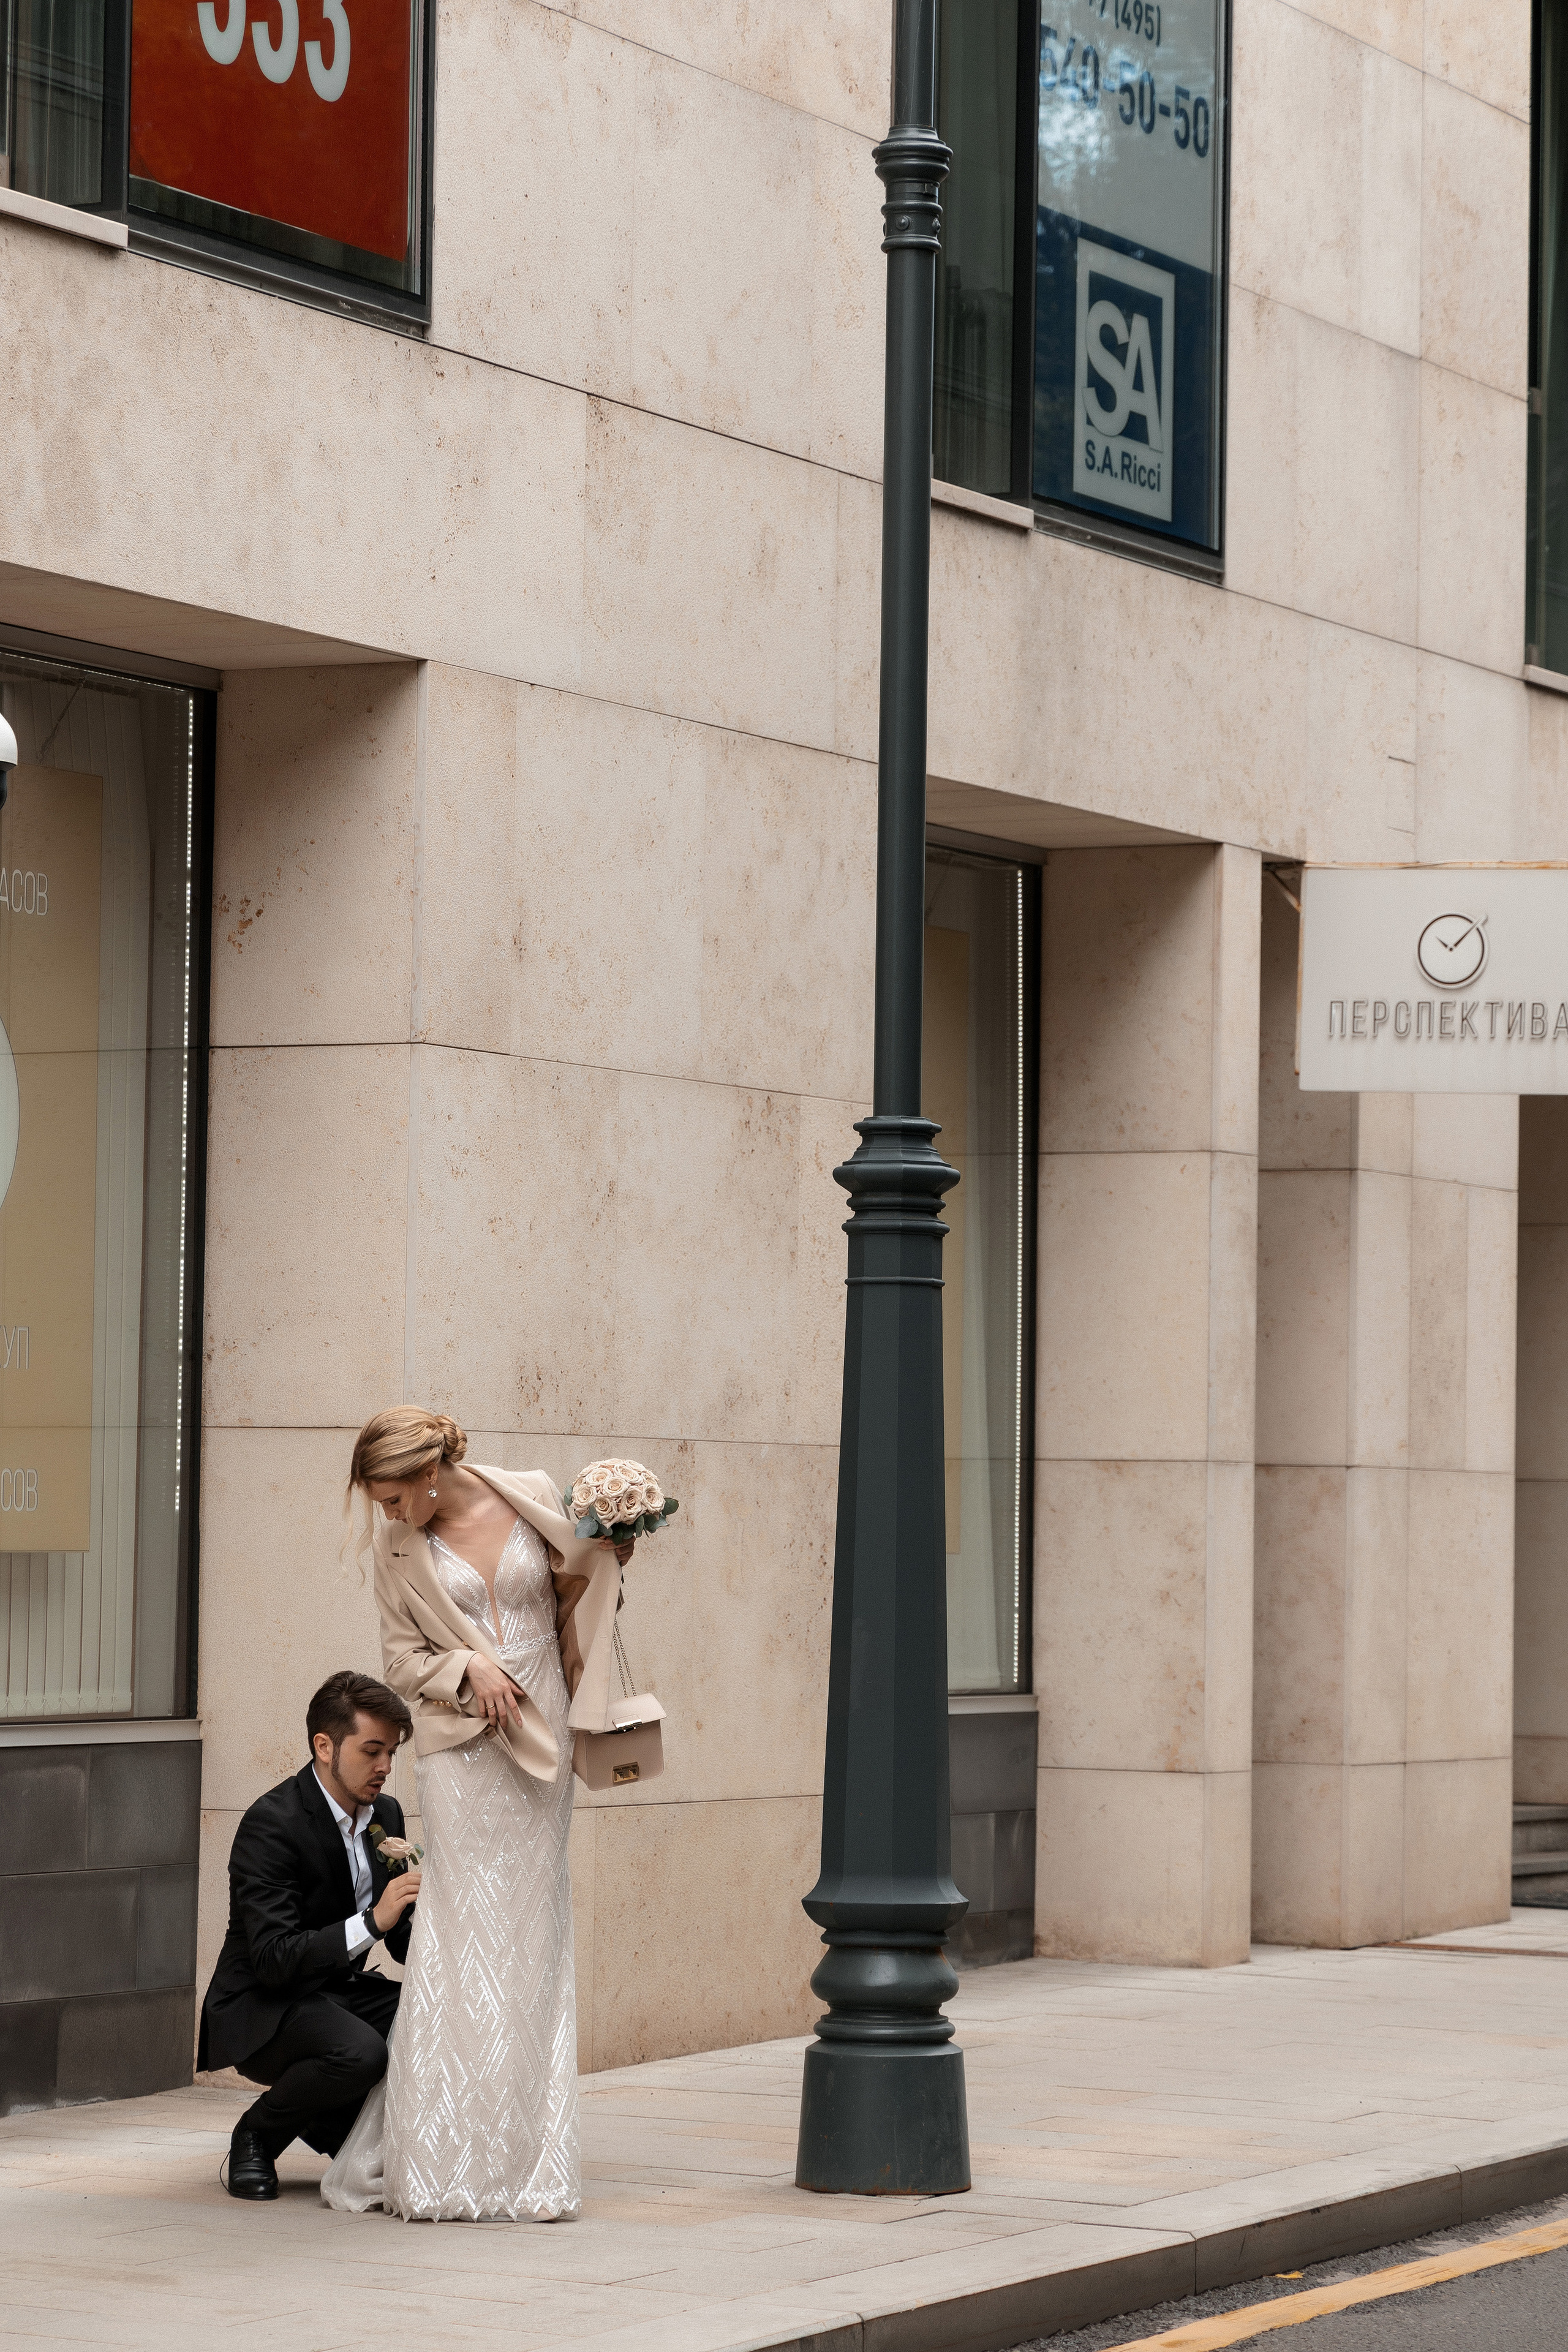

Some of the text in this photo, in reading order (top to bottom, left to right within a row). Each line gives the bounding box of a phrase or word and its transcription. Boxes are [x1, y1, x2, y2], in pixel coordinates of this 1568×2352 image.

[1082, 300, 1163, 453] SA
[1328, 1000, 1568, 1040] ПЕРСПЕКТИВА
[0, 1325, 29, 1370] УП
[1, 1468, 39, 1512] СОВ
